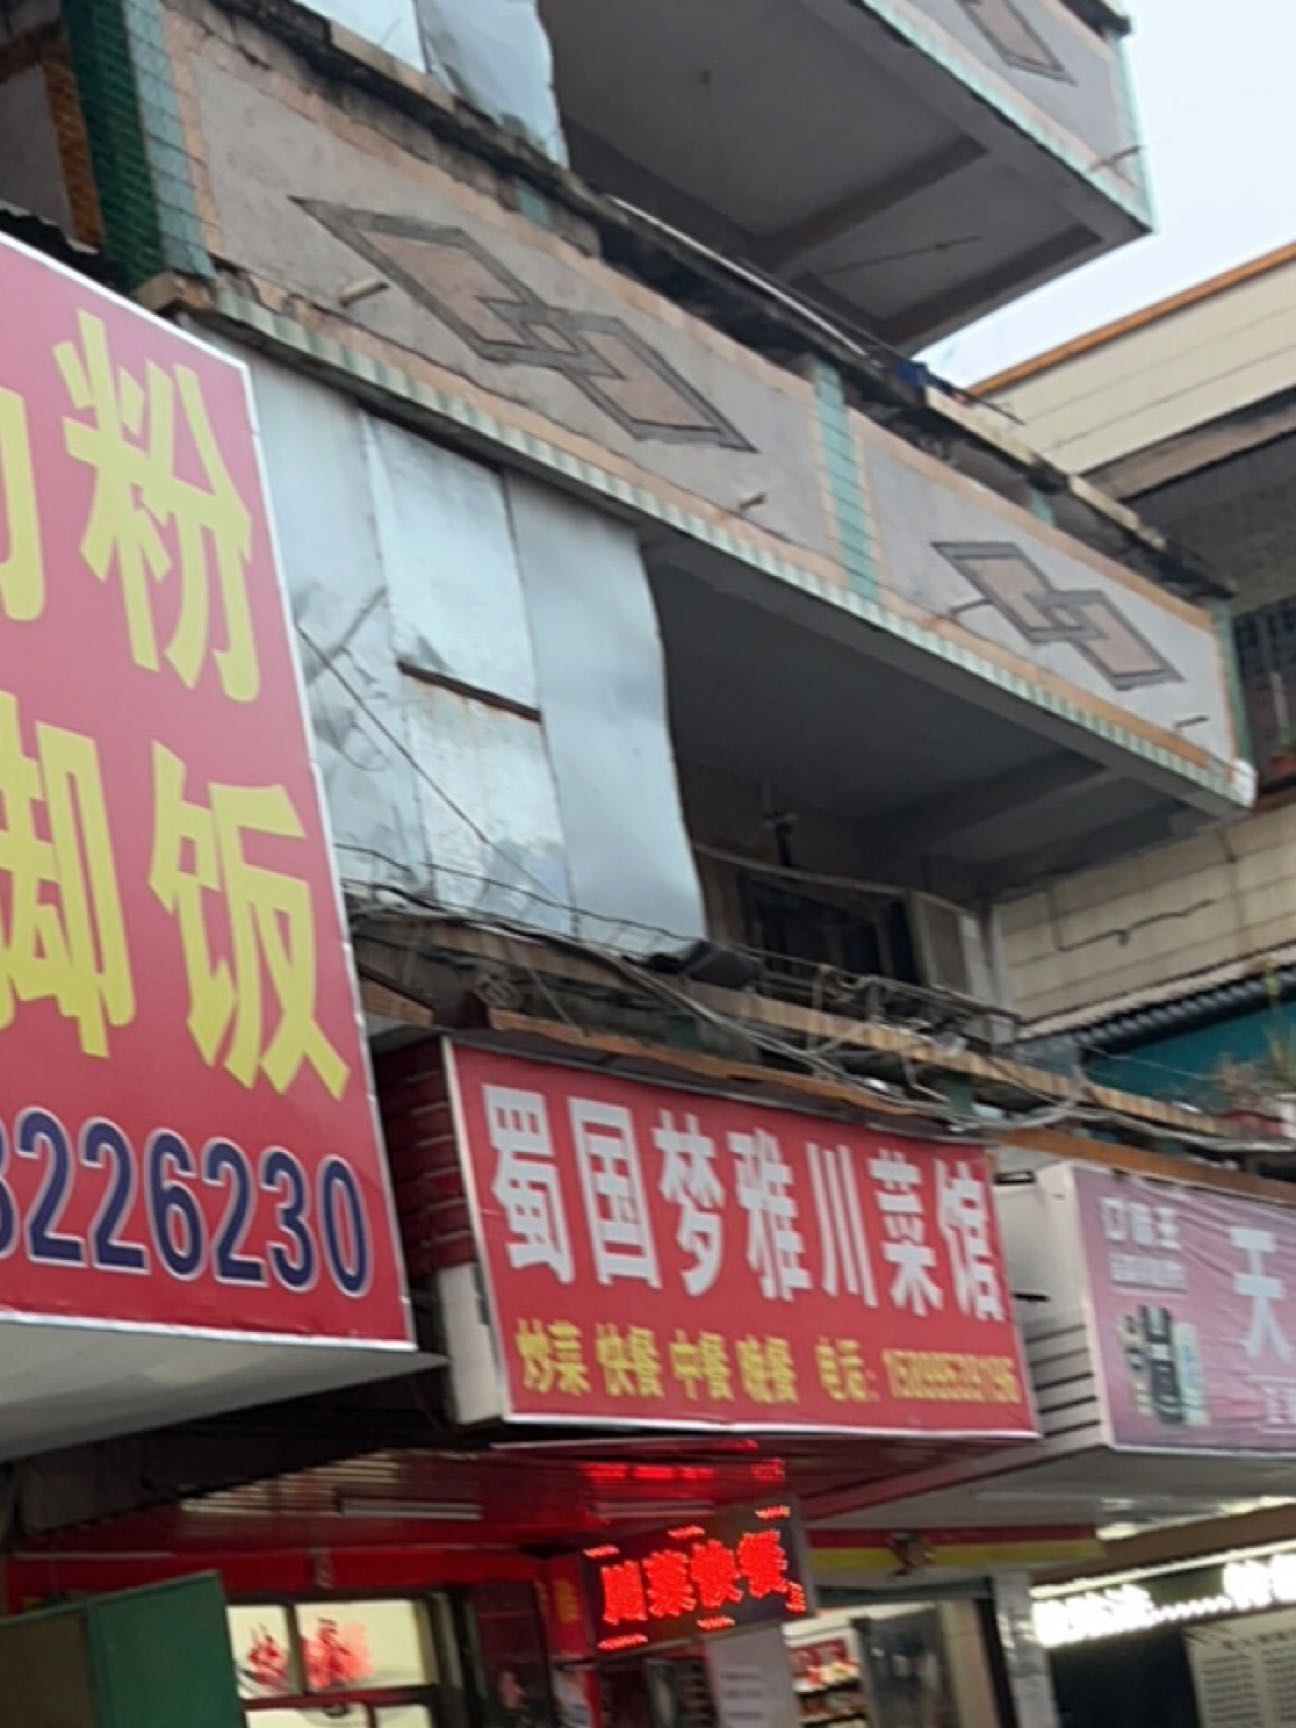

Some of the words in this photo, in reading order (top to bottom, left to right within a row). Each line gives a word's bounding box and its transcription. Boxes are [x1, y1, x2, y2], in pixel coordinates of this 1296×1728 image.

[481, 1083, 1005, 1322] 蜀国梦雅川菜馆
